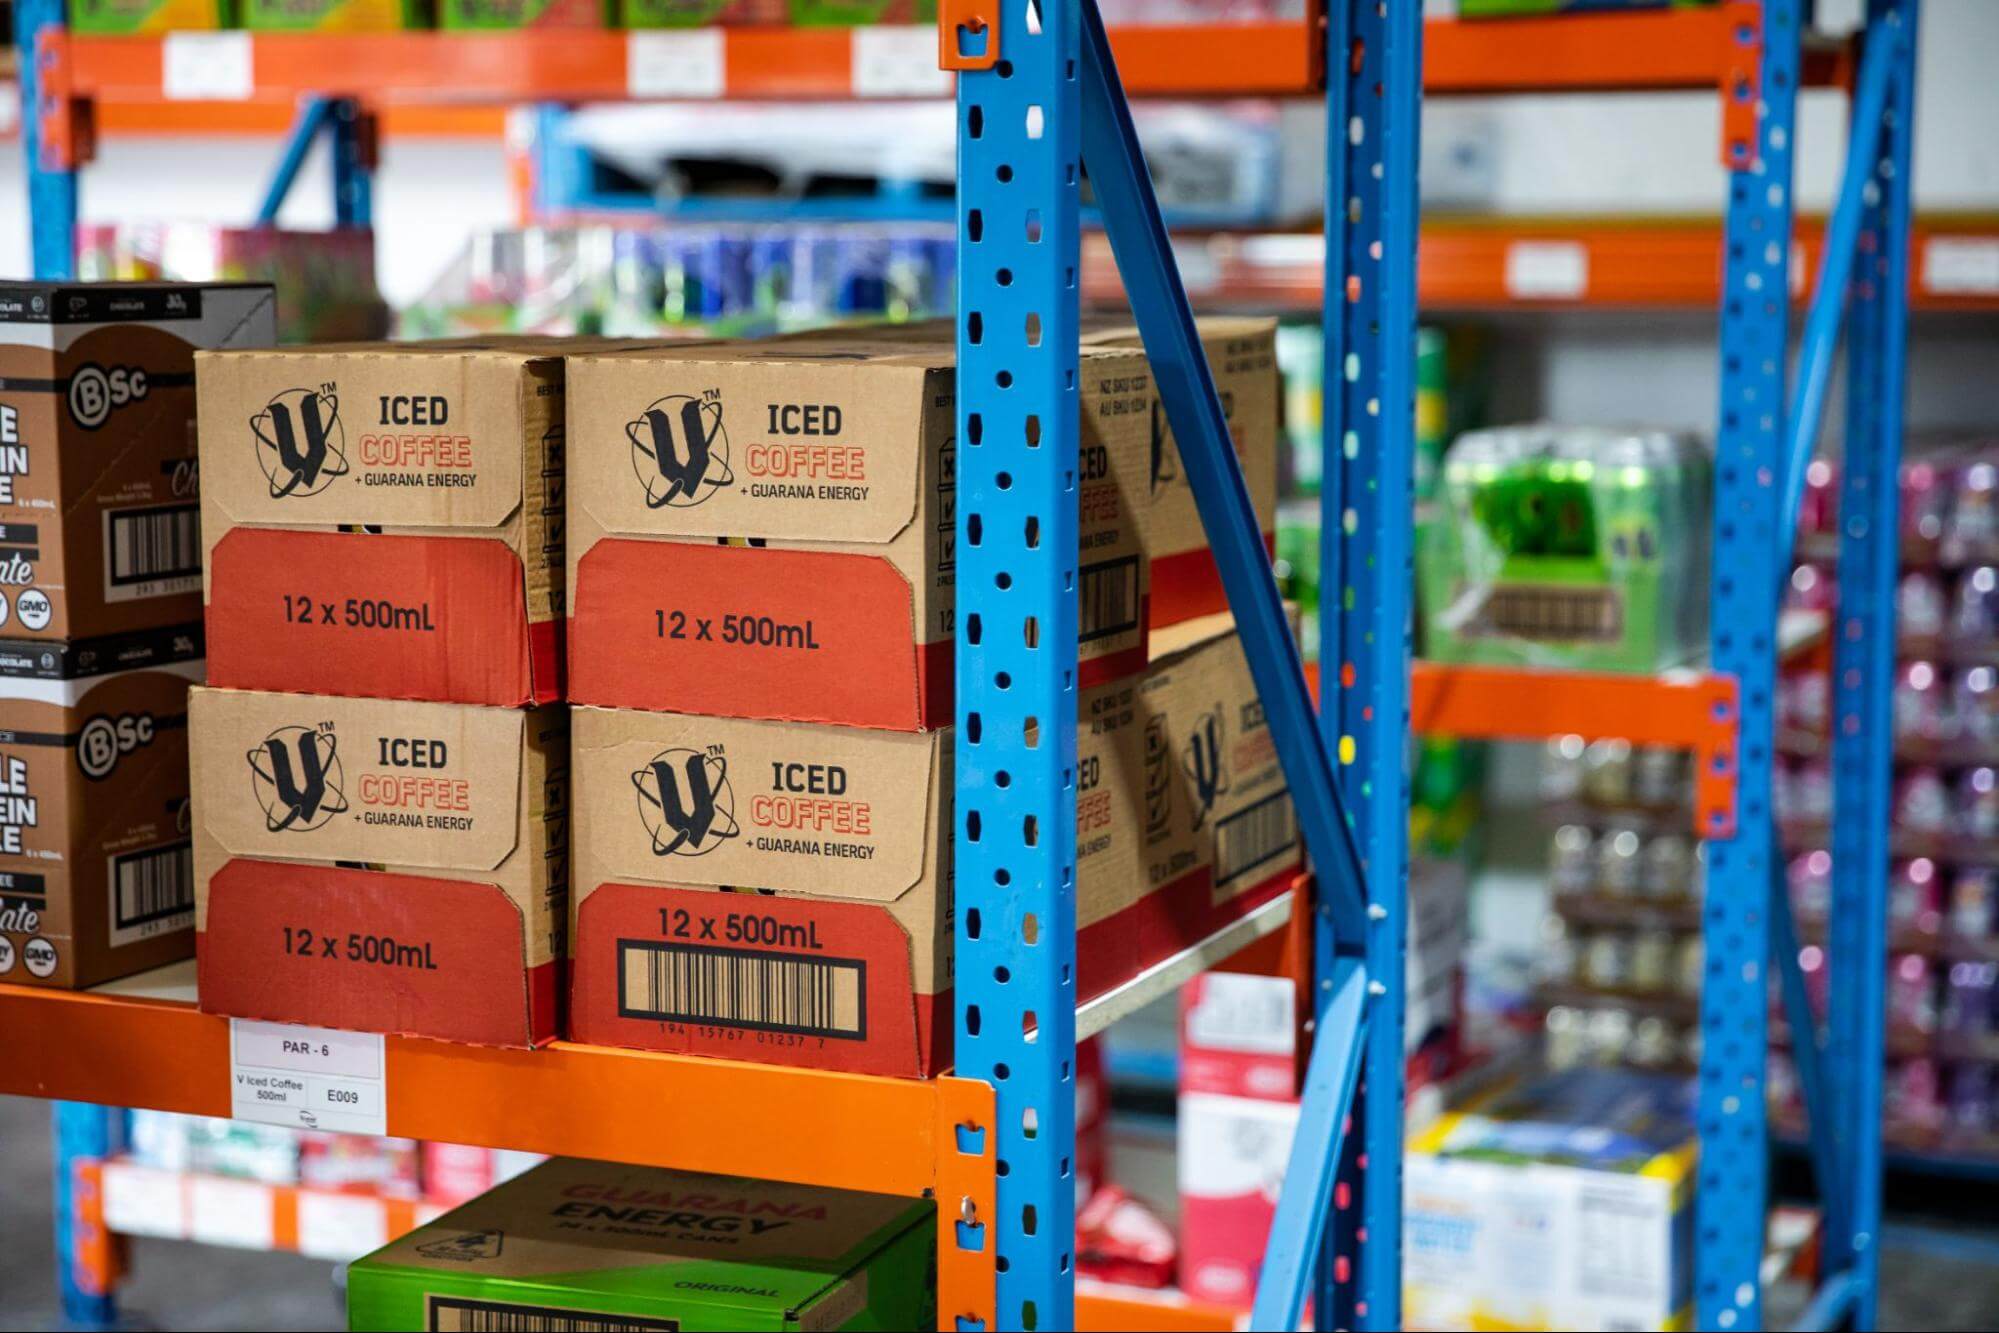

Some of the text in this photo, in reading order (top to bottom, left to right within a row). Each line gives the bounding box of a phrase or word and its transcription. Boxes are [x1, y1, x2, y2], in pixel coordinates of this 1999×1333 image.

[379, 396, 448, 425] ICED
[768, 404, 842, 435] ICED
[360, 435, 472, 467] COFFEE
[746, 444, 865, 480] COFFEE
[1079, 445, 1107, 481] CED
[365, 473, 424, 487] GUARANA
[427, 473, 477, 488] ENERGY
[751, 484, 816, 499] GUARANA
[819, 486, 869, 501] ENERGY
[284, 595, 434, 631] 12 x 500mL
[655, 610, 820, 649] 12 x 500mL
[378, 737, 447, 769] ICED
[772, 762, 846, 796] ICED
[1077, 756, 1099, 791] ED
[359, 774, 470, 811] COFFEE
[364, 812, 423, 828] GUARANA
[427, 815, 473, 831] ENERGY
[751, 795, 871, 835] COFFEE
[757, 837, 820, 857] GUARANA
[824, 842, 875, 860] ENERGY
[658, 908, 823, 949] 12 x 500mL
[283, 927, 437, 969] 12 x 500mL
[283, 1040, 310, 1054] PAR
[322, 1045, 329, 1057] 6
[659, 1022, 825, 1049] 194 15767 01237 7
[237, 1075, 303, 1090] V Iced Coffee
[257, 1091, 287, 1101] 500ml
[327, 1089, 359, 1104] E009
[560, 1184, 827, 1220] GUARANA
[552, 1202, 791, 1235] ENERGY
[674, 1281, 780, 1298] ORIGINAL
